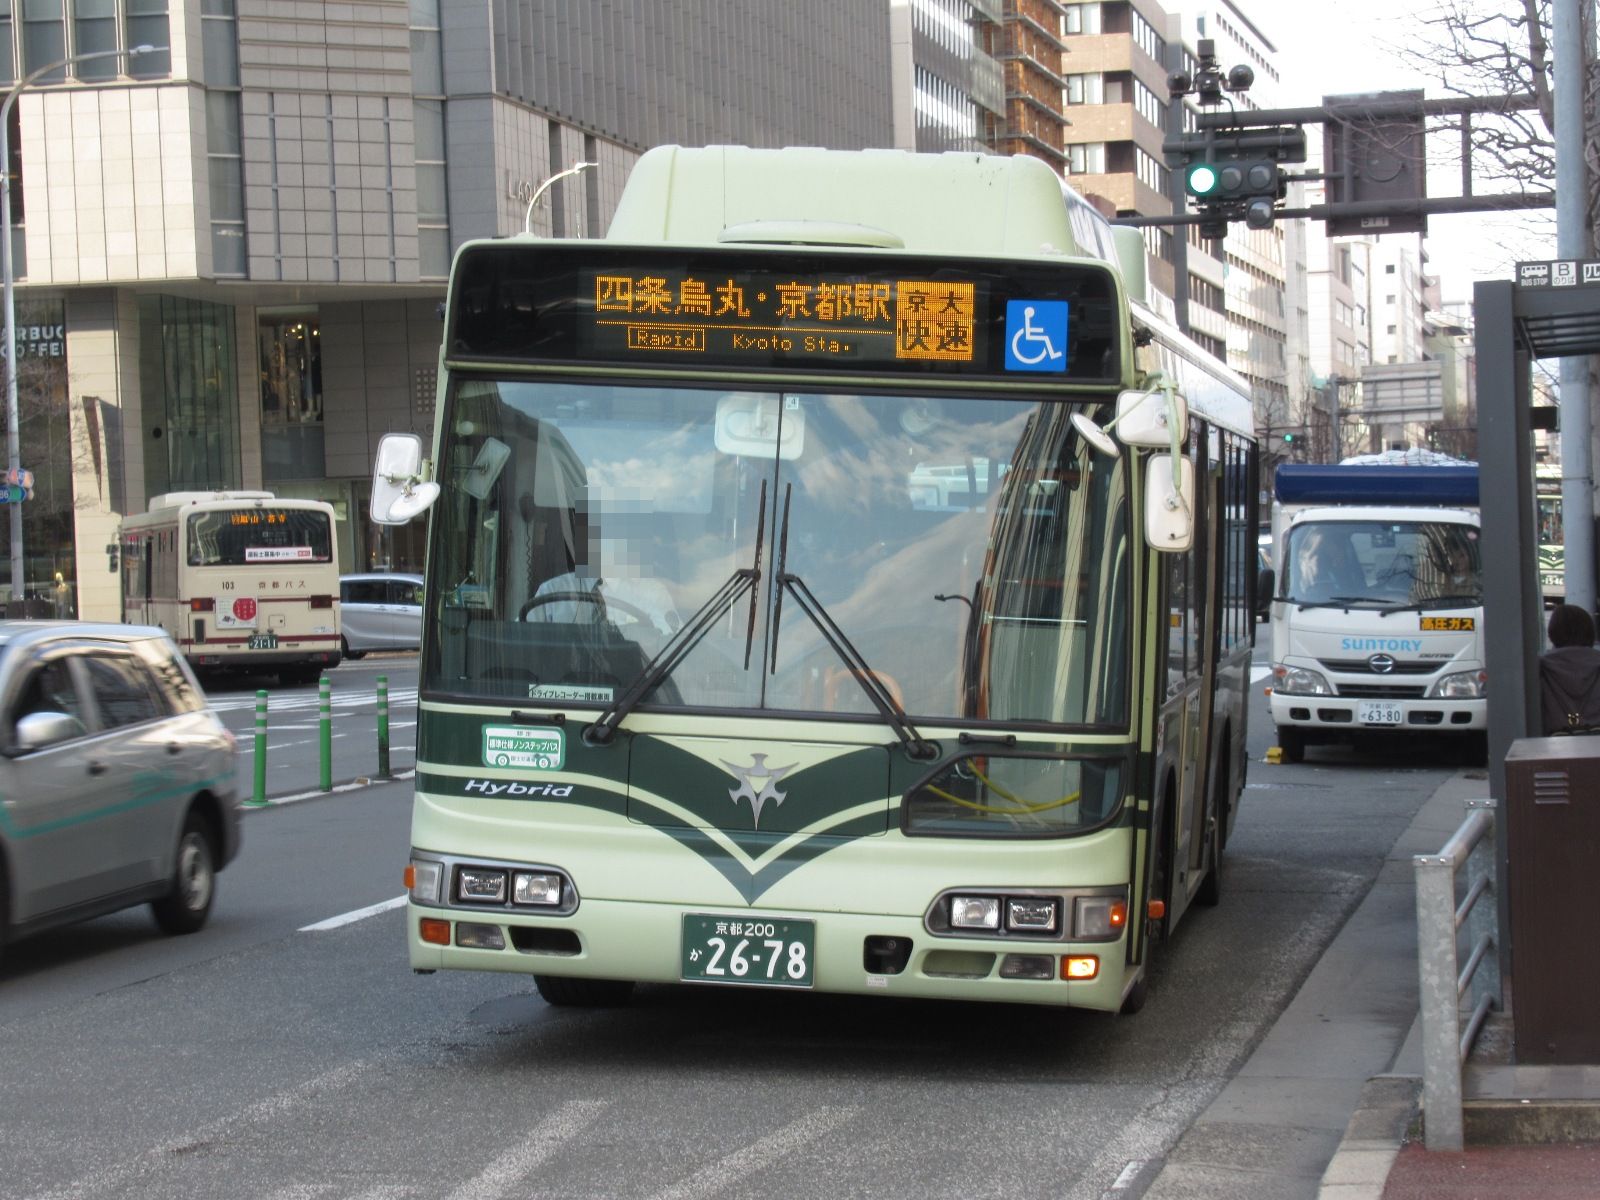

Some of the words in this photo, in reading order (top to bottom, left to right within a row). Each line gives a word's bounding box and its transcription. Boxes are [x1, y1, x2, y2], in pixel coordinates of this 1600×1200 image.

[1558, 263, 1570, 276] B
[1521, 278, 1533, 287] BUS
[1533, 277, 1548, 286] STOP
[905, 289, 964, 315] 京大
[637, 329, 696, 348] Rapid
[733, 333, 792, 351] Kyoto
[804, 335, 850, 353] Sta.
[898, 319, 969, 353] 快速
[222, 581, 235, 590] 103
[1422, 617, 1474, 631] 高圧ガス
[1368, 710, 1401, 722] 63-80
[464, 779, 574, 797] Hybrid
[689, 948, 703, 962] か
[706, 937, 807, 980] 26-78
